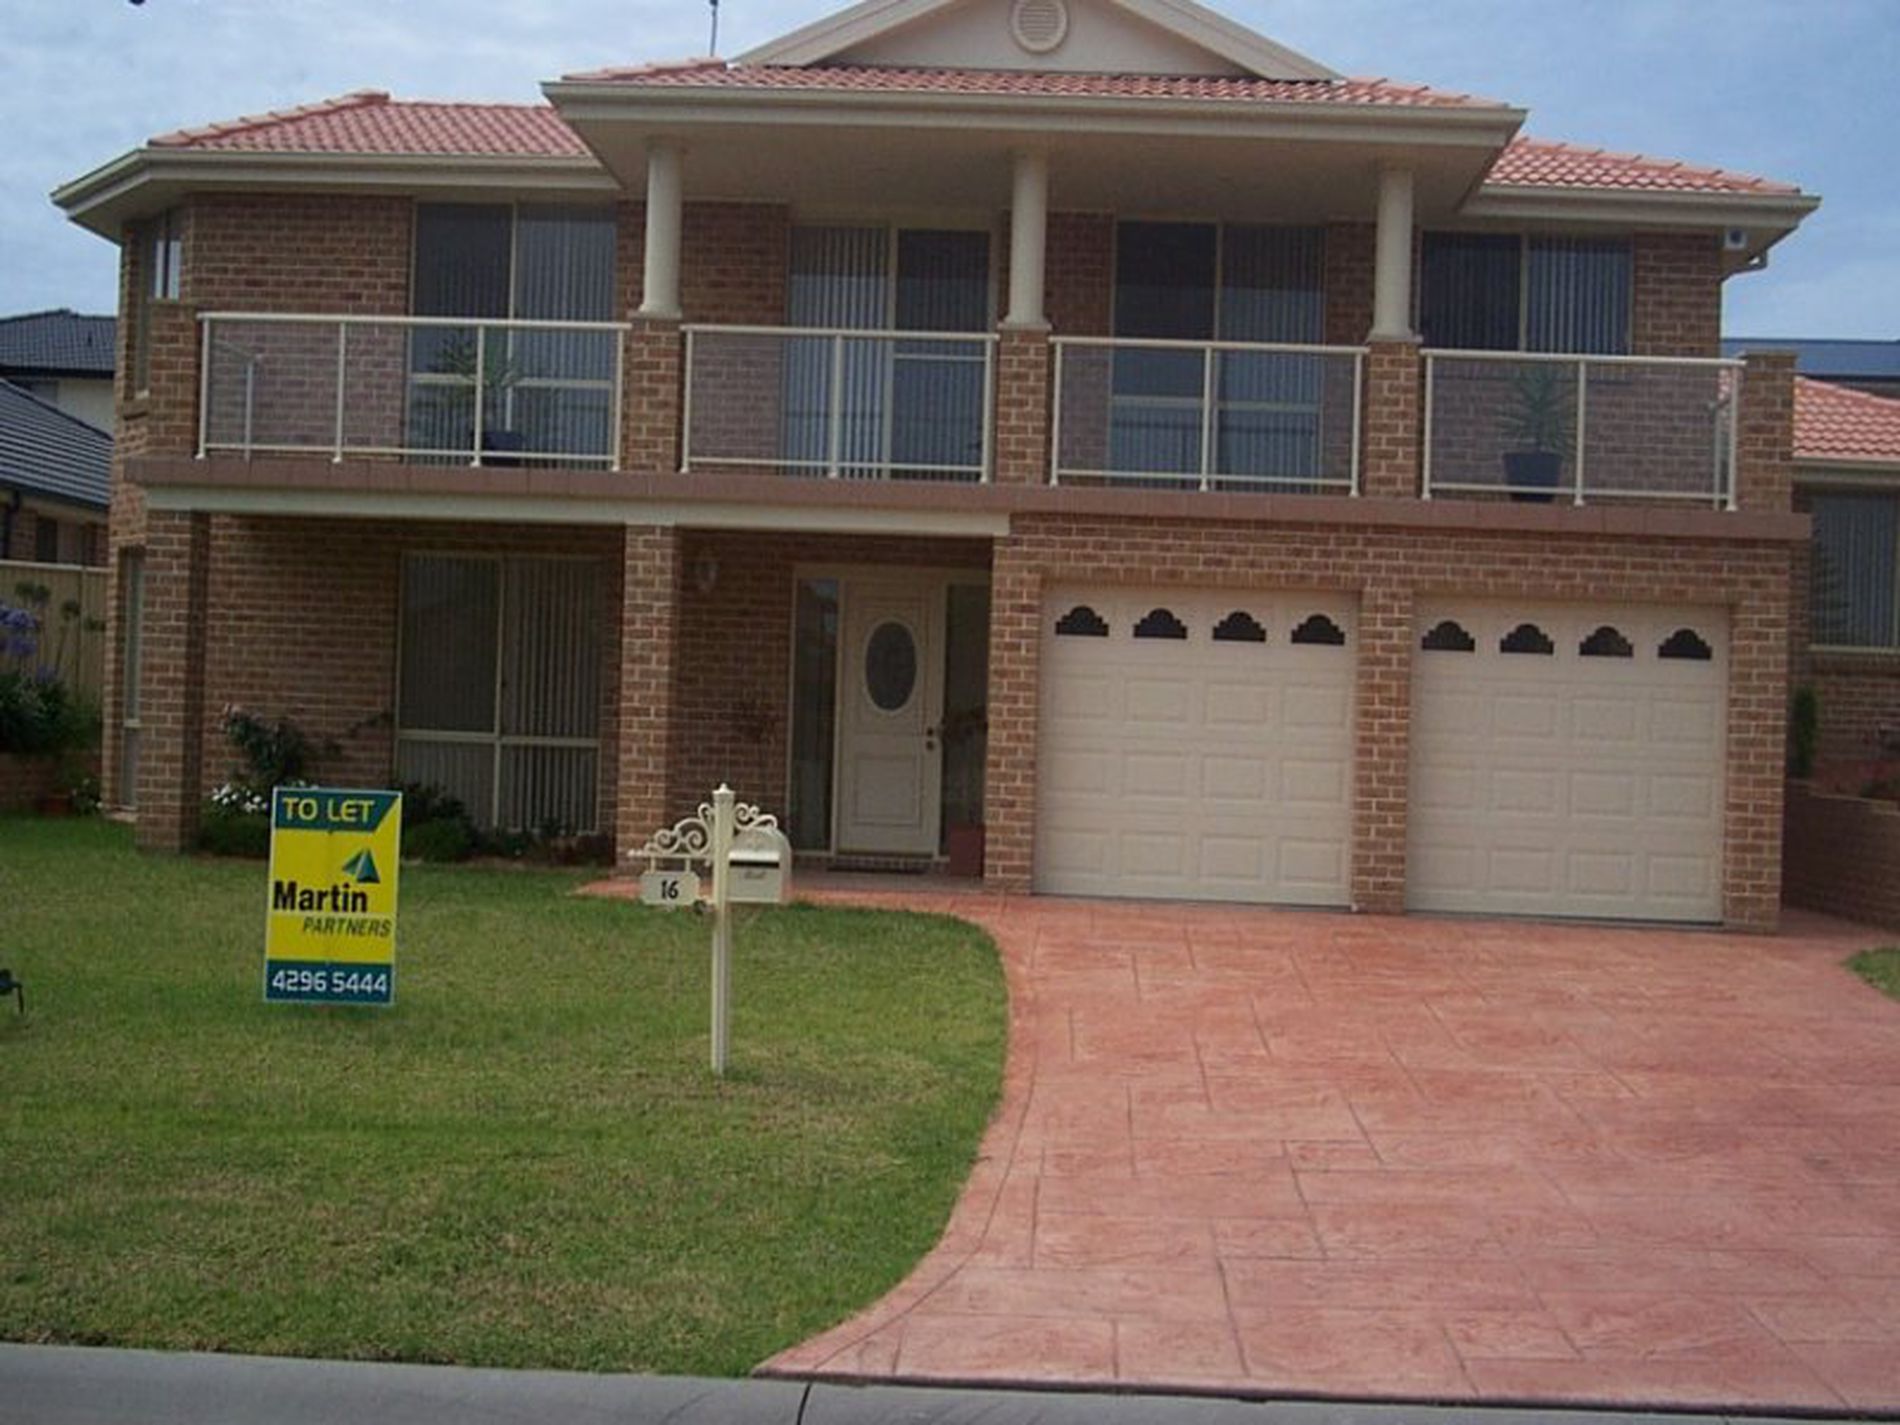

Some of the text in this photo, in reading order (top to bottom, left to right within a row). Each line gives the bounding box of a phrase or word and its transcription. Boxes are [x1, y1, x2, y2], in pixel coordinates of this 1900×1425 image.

[282, 798, 374, 822] TO LET
[273, 881, 367, 912] Martin
[661, 879, 679, 899] 16
[303, 916, 391, 938] PARTNERS
[272, 970, 387, 994] 4296 5444
